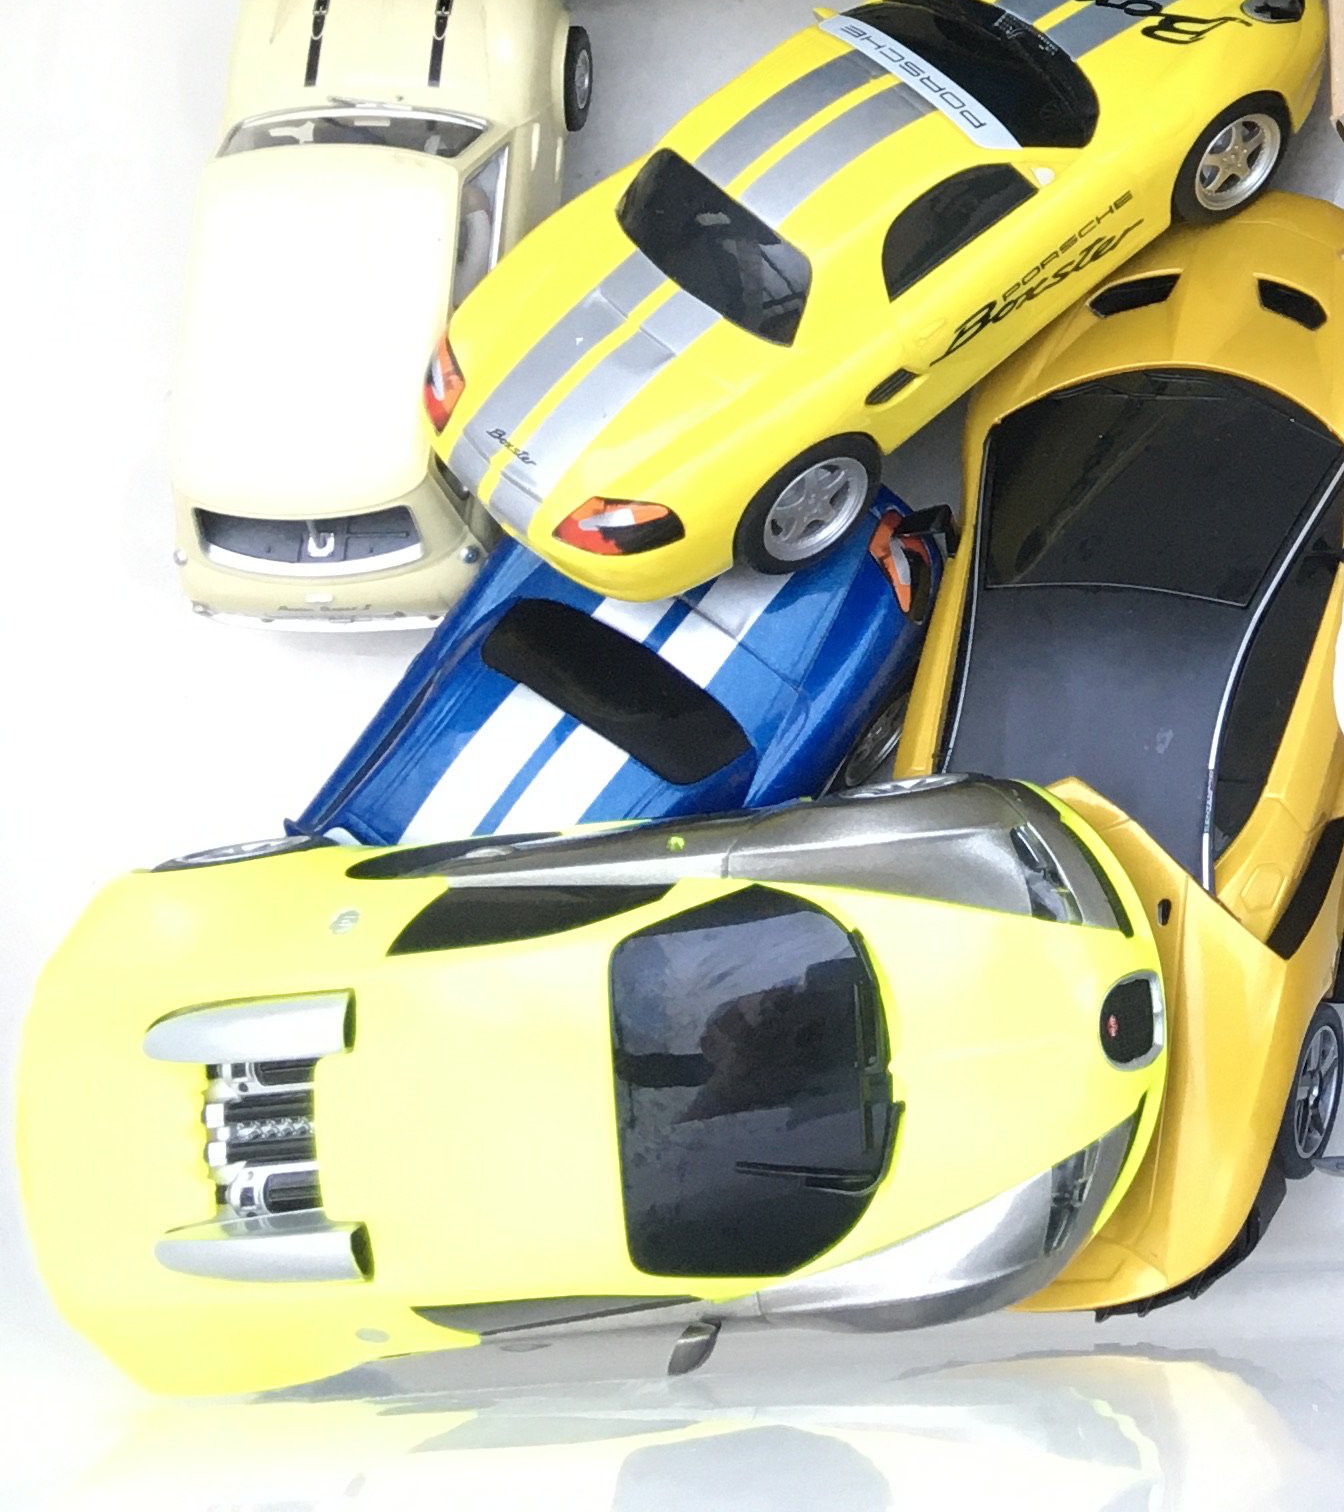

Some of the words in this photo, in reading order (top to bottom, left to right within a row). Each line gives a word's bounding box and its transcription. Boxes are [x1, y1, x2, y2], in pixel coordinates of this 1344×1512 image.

[840, 23, 986, 130] PORSCHE
[930, 219, 1144, 366] Boxster
[1002, 190, 1133, 302] PORSCHE
[487, 428, 537, 467] Boxster
